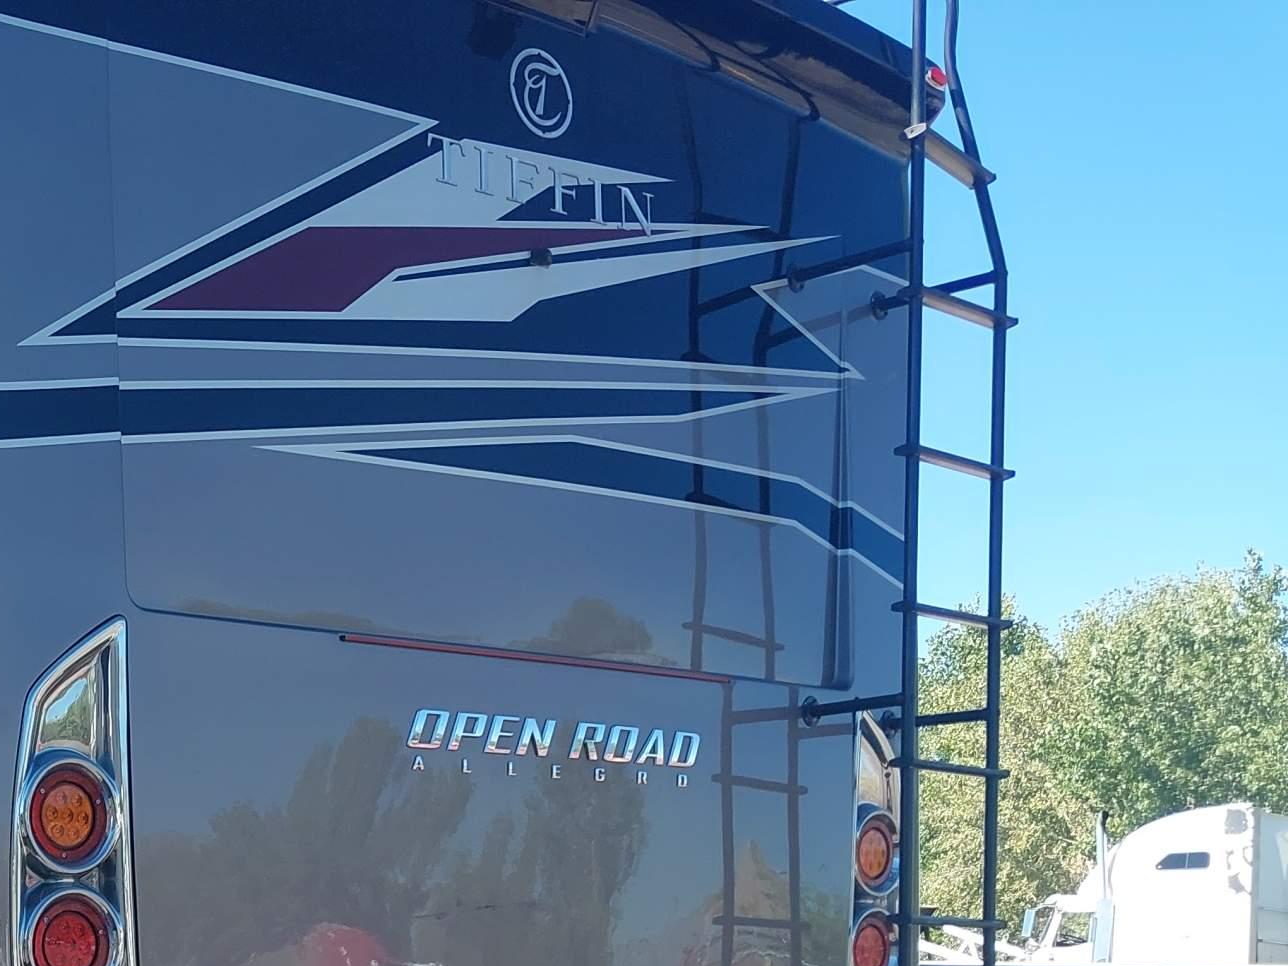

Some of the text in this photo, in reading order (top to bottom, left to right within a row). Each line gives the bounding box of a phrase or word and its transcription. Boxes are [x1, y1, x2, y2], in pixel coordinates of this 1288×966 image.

[427, 132, 655, 237] TIFFIN
[406, 708, 701, 768] OPEN ROAD
[411, 754, 689, 789] ALLEGRO
